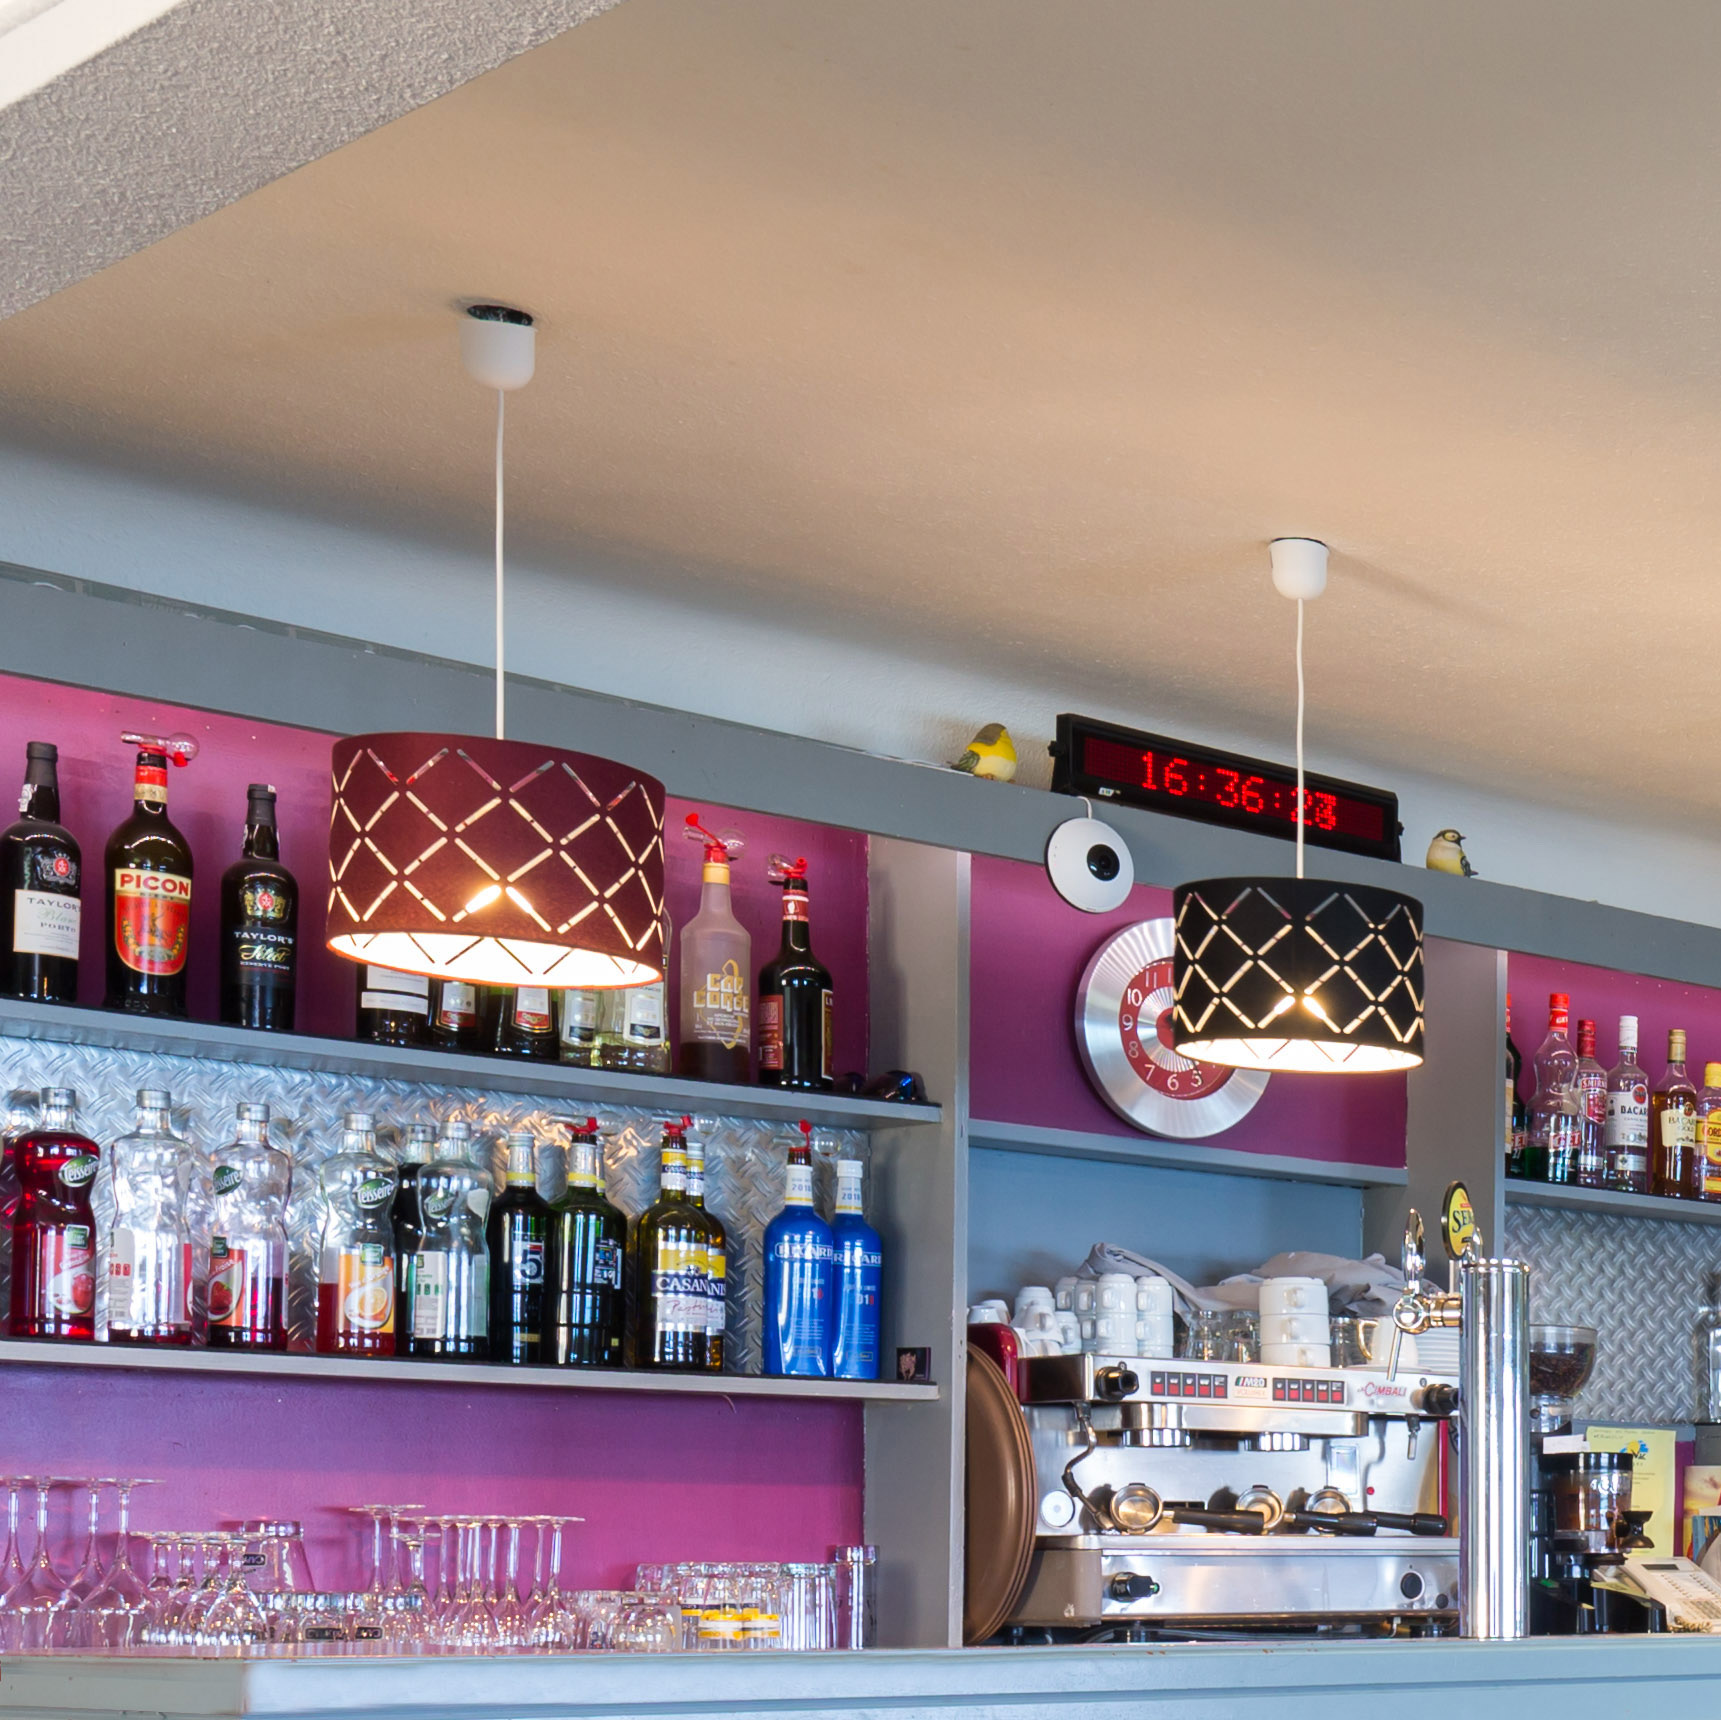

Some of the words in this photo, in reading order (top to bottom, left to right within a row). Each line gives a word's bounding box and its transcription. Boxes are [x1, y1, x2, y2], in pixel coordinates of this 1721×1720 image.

[120, 873, 189, 897] PICON
[234, 931, 294, 944] TAYLOR'S
[1127, 989, 1142, 1006] 10
[1123, 1014, 1133, 1030] 9
[1128, 1041, 1139, 1058] 8
[1145, 1064, 1155, 1081] 7
[1191, 1070, 1202, 1087] 5
[1167, 1074, 1179, 1091] 6
[1621, 1104, 1648, 1115] BACAR
[63, 1157, 99, 1181] Teisseire
[1364, 1382, 1406, 1397] CIMBALI
